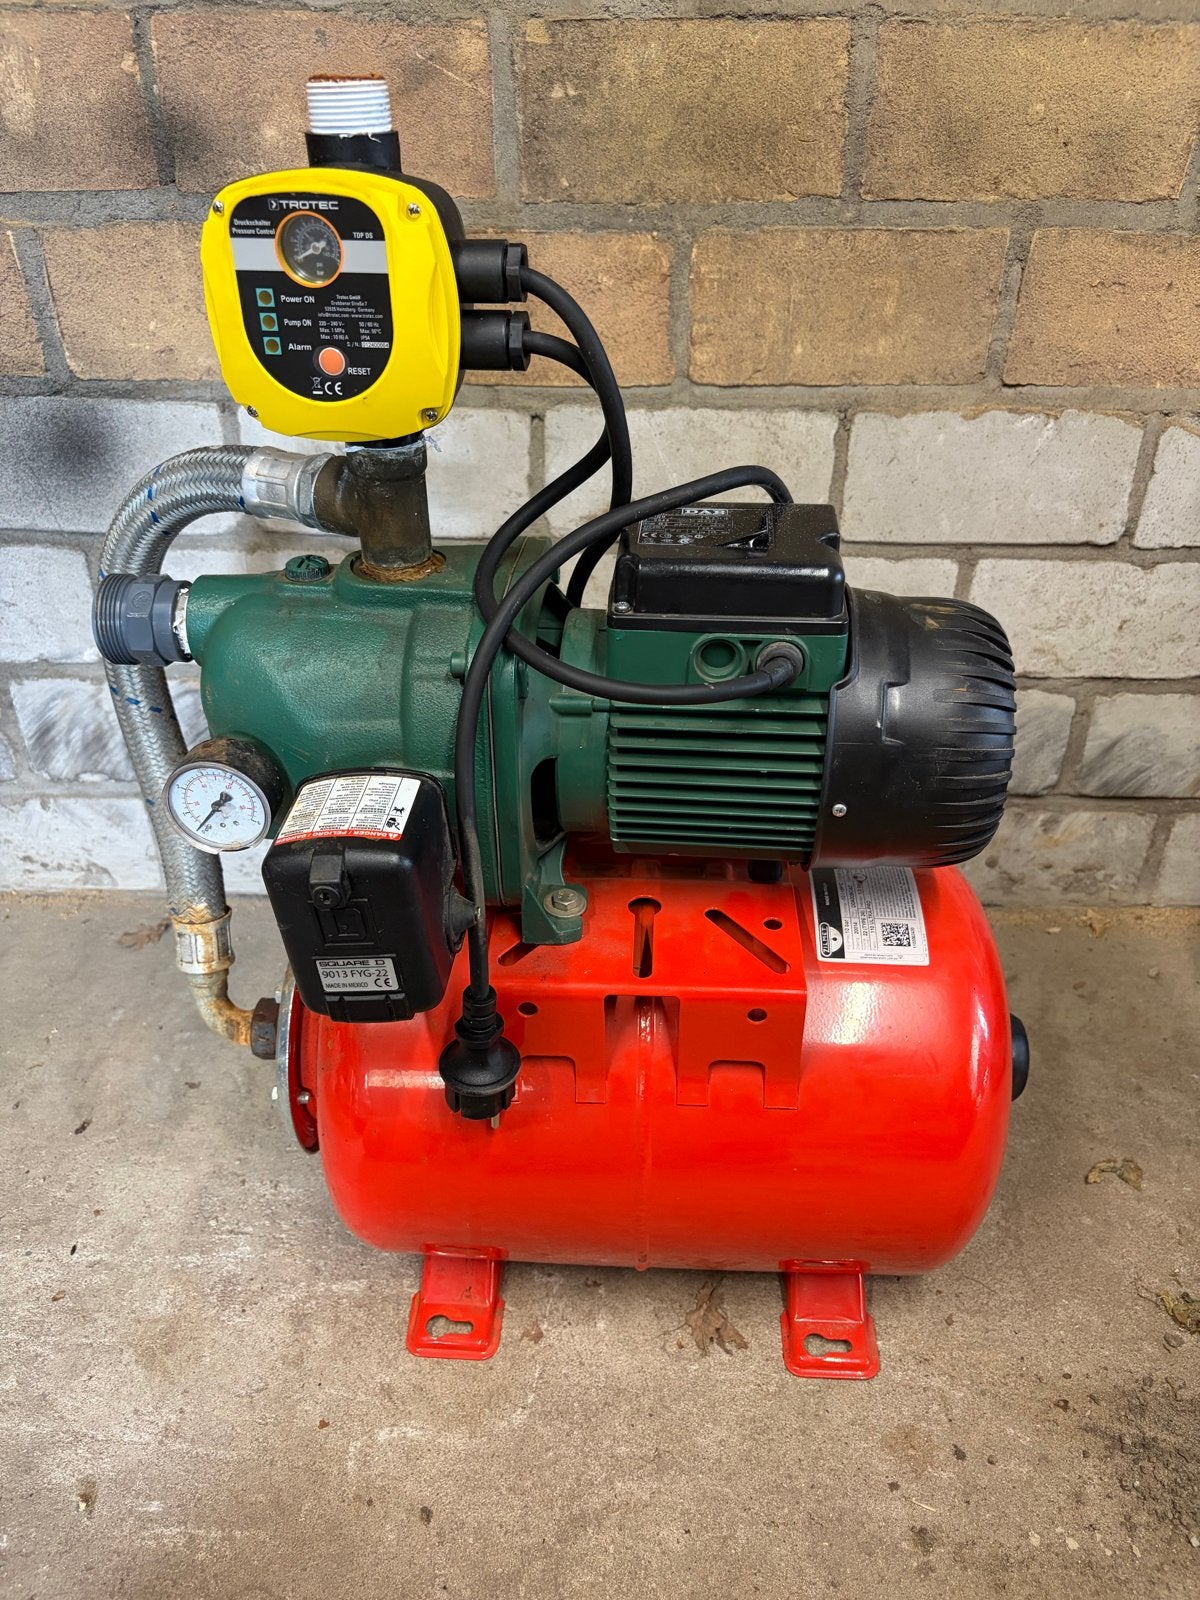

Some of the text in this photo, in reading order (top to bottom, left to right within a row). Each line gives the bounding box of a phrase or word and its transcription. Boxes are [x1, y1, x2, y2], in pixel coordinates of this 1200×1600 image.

[279, 199, 339, 210] TROTEC
[233, 218, 271, 227] Druckschalter
[232, 227, 255, 235] Pressure
[280, 294, 315, 304] Power ON
[283, 318, 312, 328] Pump ON
[288, 342, 312, 351] Alarm
[347, 367, 372, 376] RESET
[324, 381, 343, 396] CE
[820, 925, 830, 953] ZILMET
[319, 959, 370, 967] SQUARE
[321, 968, 389, 979] 9013 FYG-22
[374, 977, 393, 988] CE
